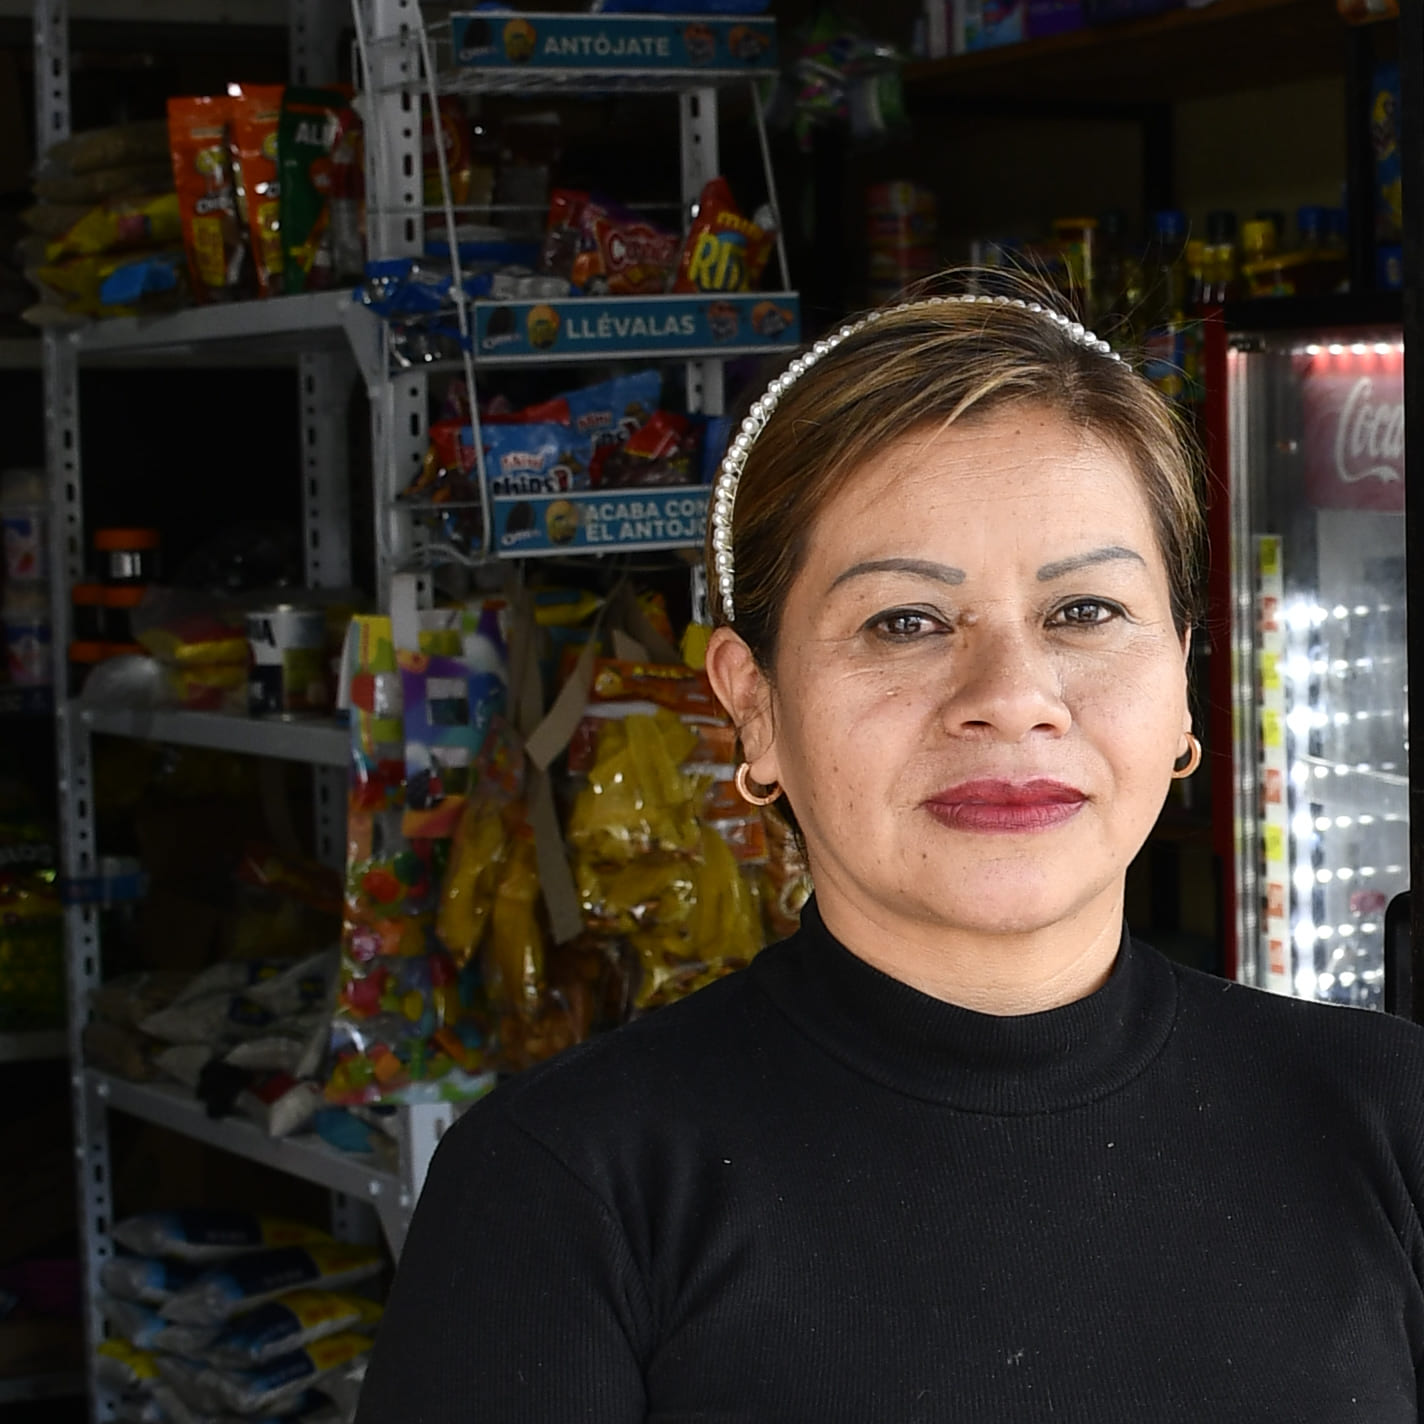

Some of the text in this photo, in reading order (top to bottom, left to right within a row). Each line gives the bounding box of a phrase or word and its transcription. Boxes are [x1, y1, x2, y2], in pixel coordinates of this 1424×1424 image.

[542, 32, 672, 57] ANTÓJATE
[566, 312, 695, 340] LLÉVALAS
[585, 499, 659, 521] ACABA
[586, 524, 614, 543] EL
